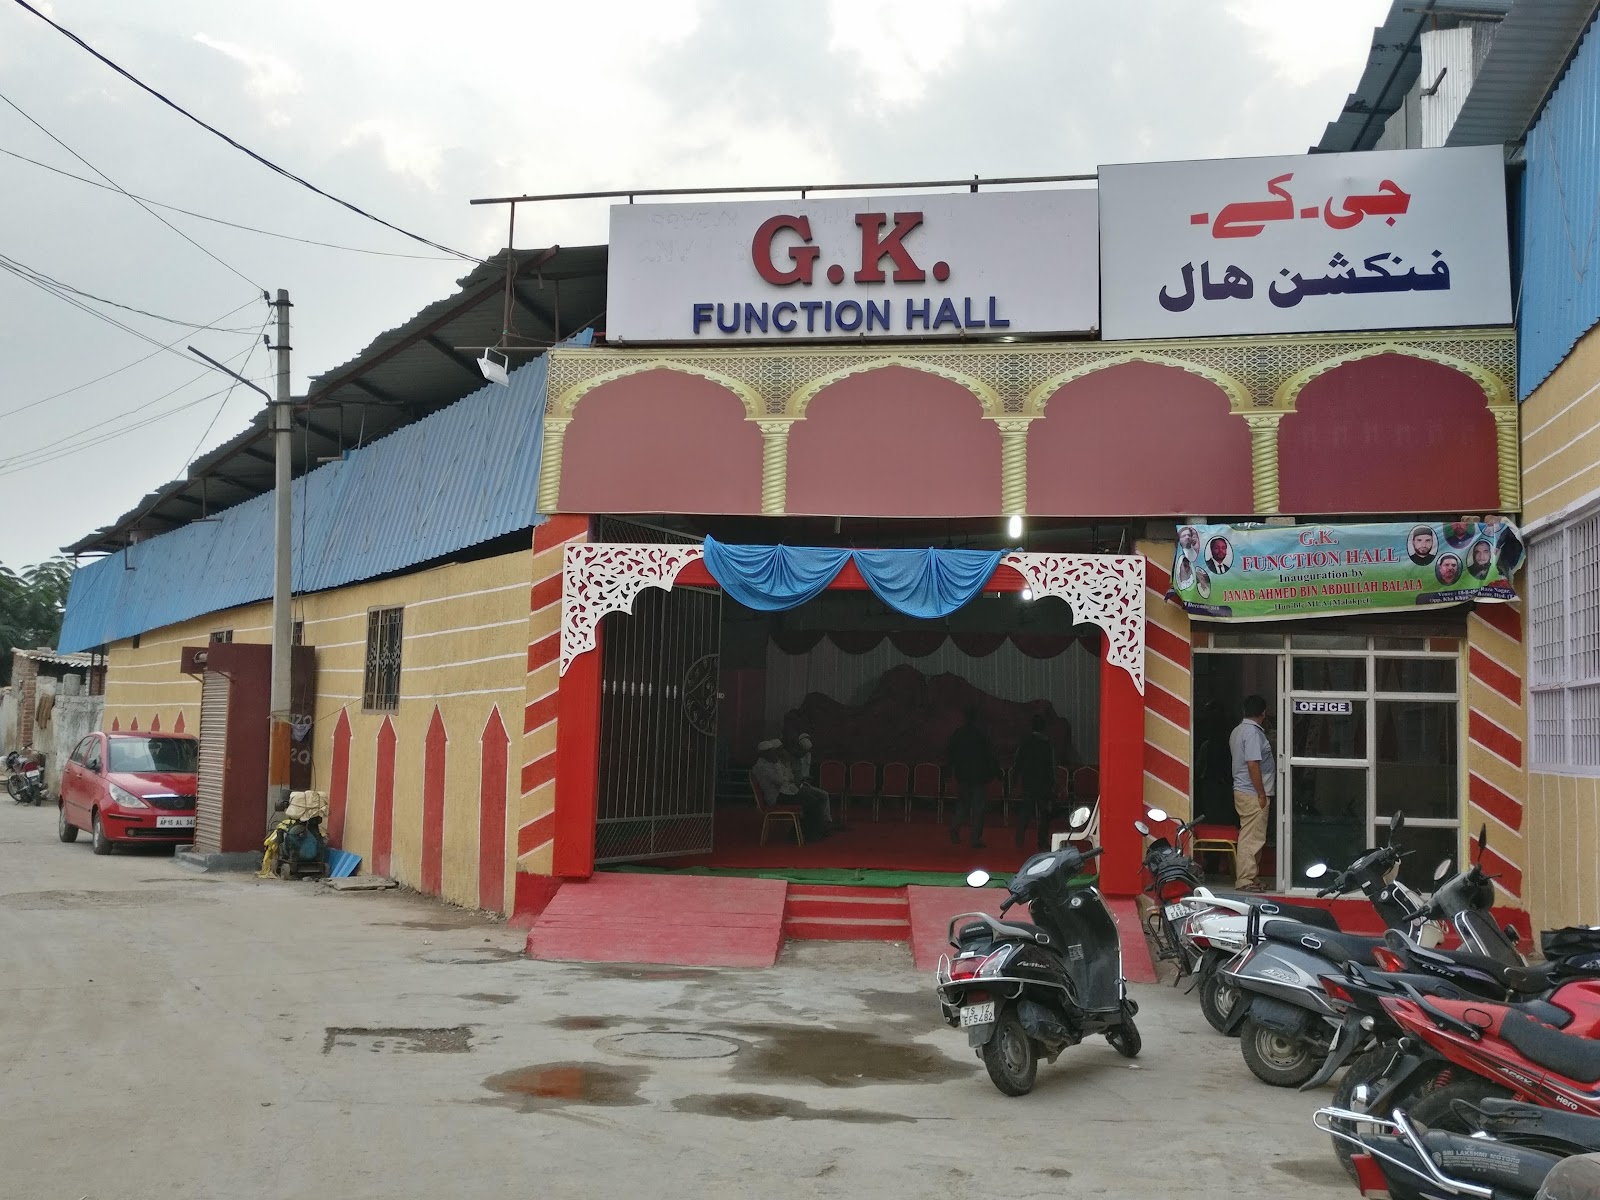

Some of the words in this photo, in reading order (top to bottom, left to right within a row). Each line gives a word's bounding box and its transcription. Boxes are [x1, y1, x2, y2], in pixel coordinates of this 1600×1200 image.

[751, 211, 950, 286] G.K.
[1268, 249, 1451, 309] فنکشن
[693, 300, 890, 335] FUNCTION
[906, 296, 1010, 330] HALL
[1299, 529, 1339, 547] G.K.
[1242, 550, 1341, 572] FUNCTION
[1345, 547, 1401, 565] HALL
[1278, 572, 1348, 583] Inauguration
[1351, 569, 1365, 579] by
[1223, 588, 1256, 602] JANAB
[1258, 586, 1297, 601] AHMED
[1299, 584, 1319, 598] BIN
[1321, 581, 1379, 597] ABDULLAH
[1381, 579, 1424, 593] BALALA
[1299, 702, 1347, 712] OFFICE
[965, 1006, 976, 1016] TS
[1555, 1094, 1579, 1111] Hero
[1455, 1150, 1488, 1158] LAKSHMI
